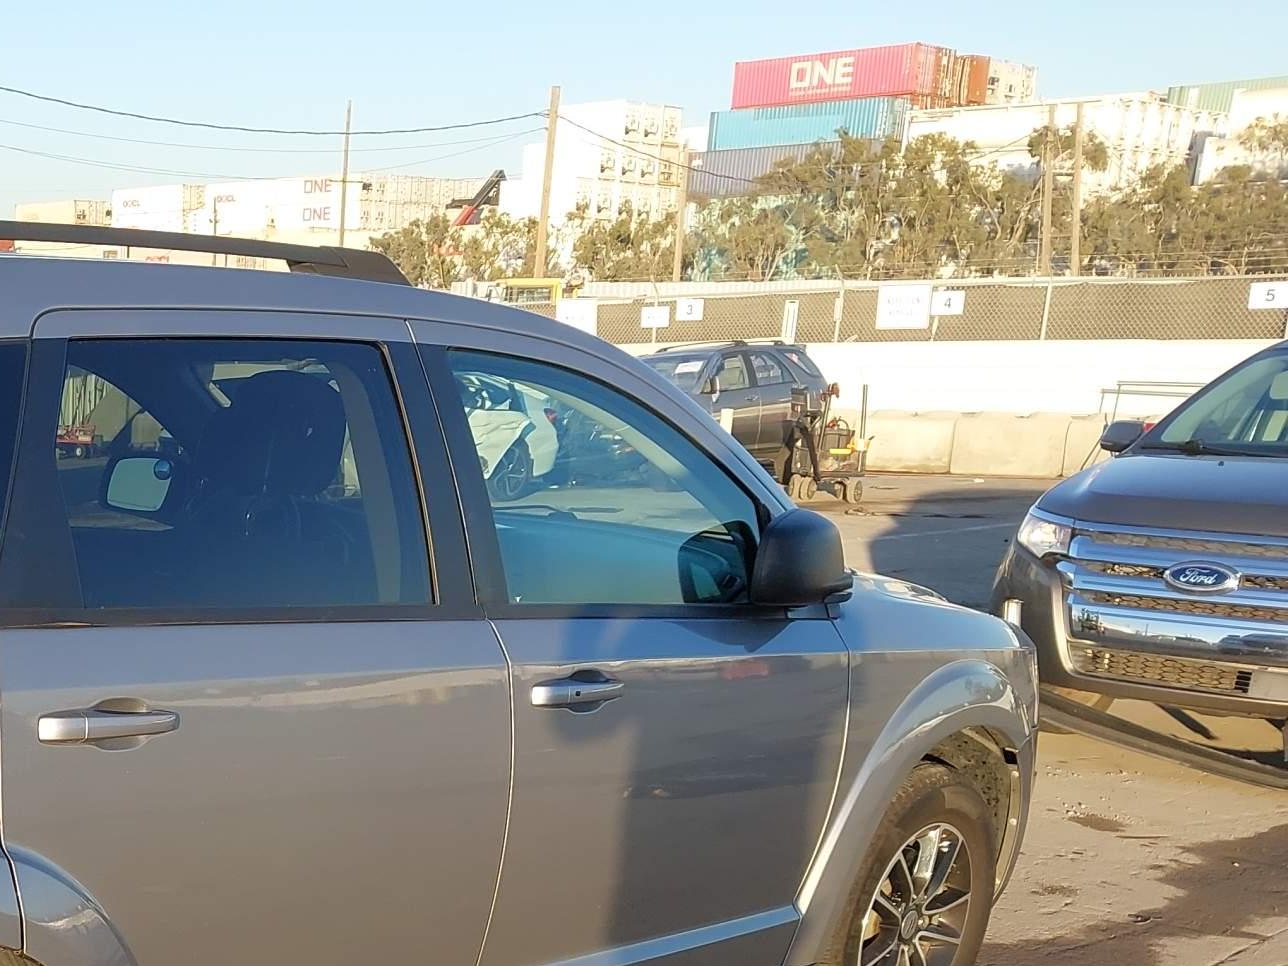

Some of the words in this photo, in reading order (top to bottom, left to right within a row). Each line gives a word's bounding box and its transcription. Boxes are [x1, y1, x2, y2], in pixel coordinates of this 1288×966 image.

[790, 57, 855, 88] ONE
[303, 179, 332, 193] ONE
[302, 207, 331, 221] ONE
[1265, 289, 1276, 301] 5
[686, 304, 693, 315] 3
[944, 297, 952, 308] 4
[1179, 568, 1218, 584] Ford
